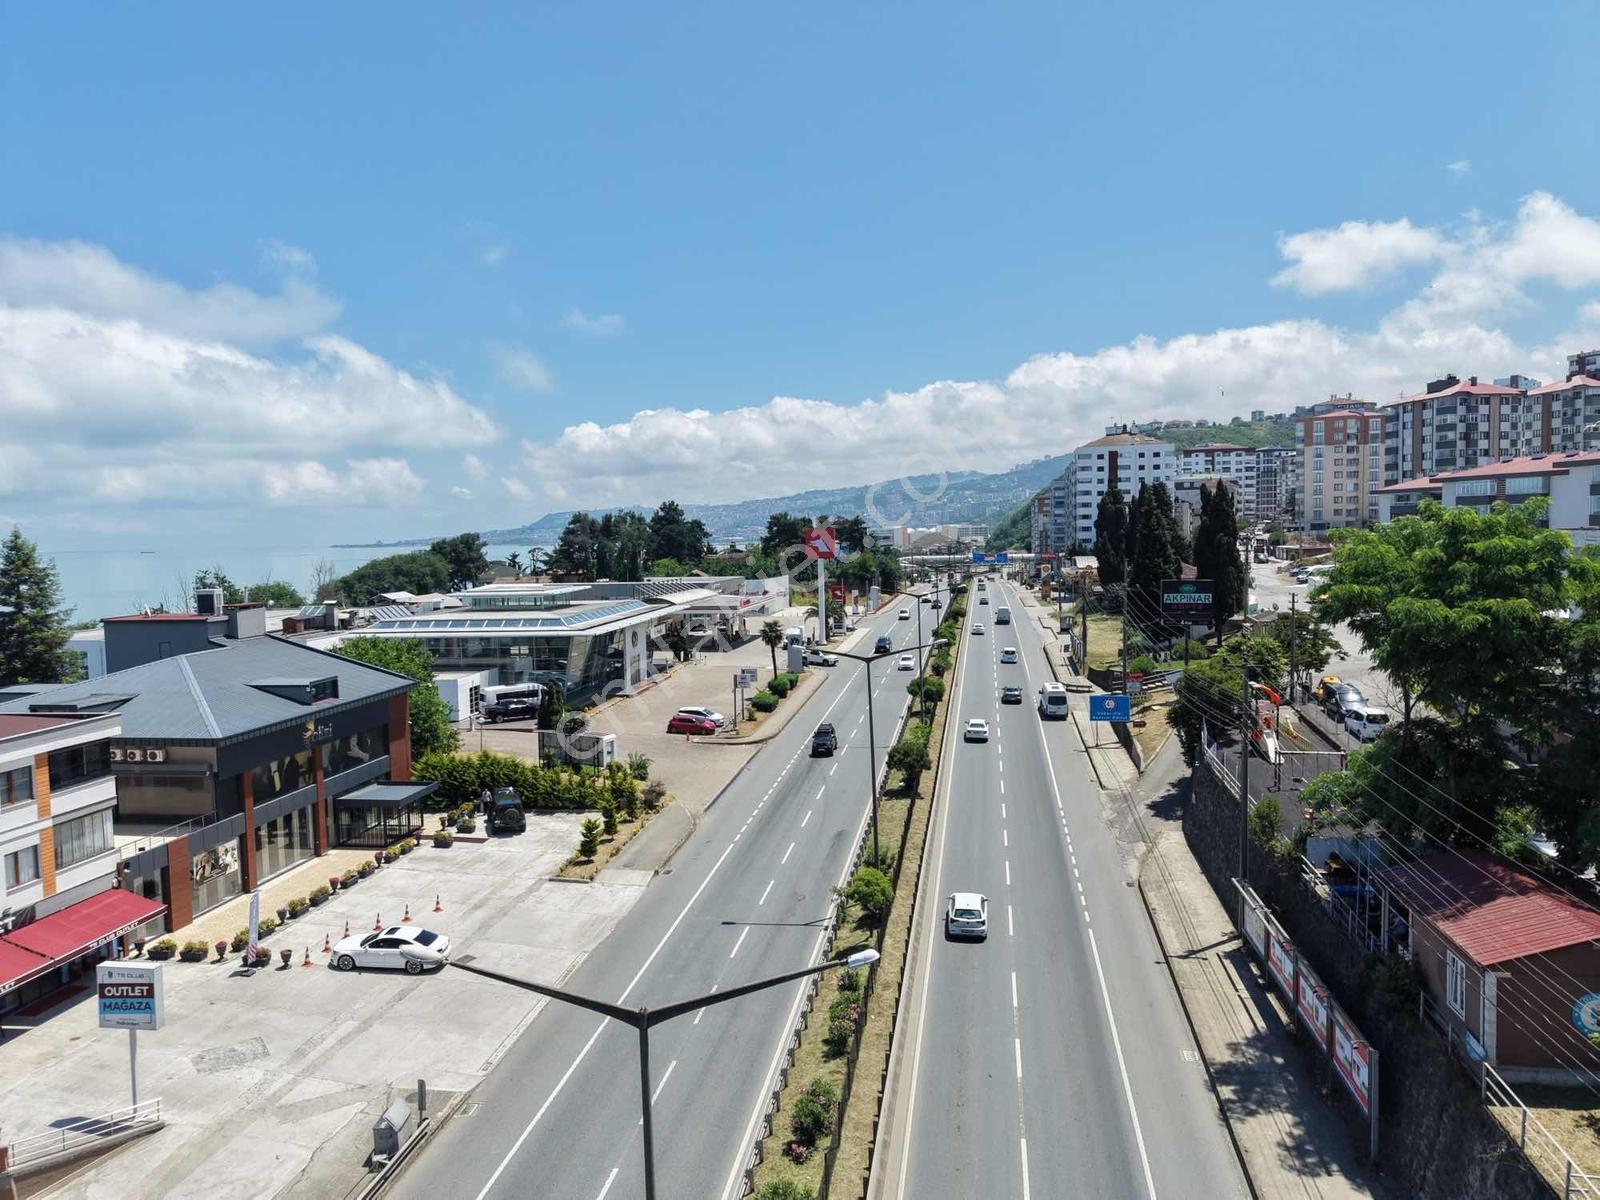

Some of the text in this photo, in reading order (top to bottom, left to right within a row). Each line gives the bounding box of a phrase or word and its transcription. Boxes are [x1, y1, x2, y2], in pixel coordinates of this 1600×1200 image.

[1165, 594, 1211, 602] AKPINAR
[116, 921, 139, 937] OUTLET
[104, 986, 149, 996] OUTLET
[103, 999, 152, 1011] MAĞAZA
